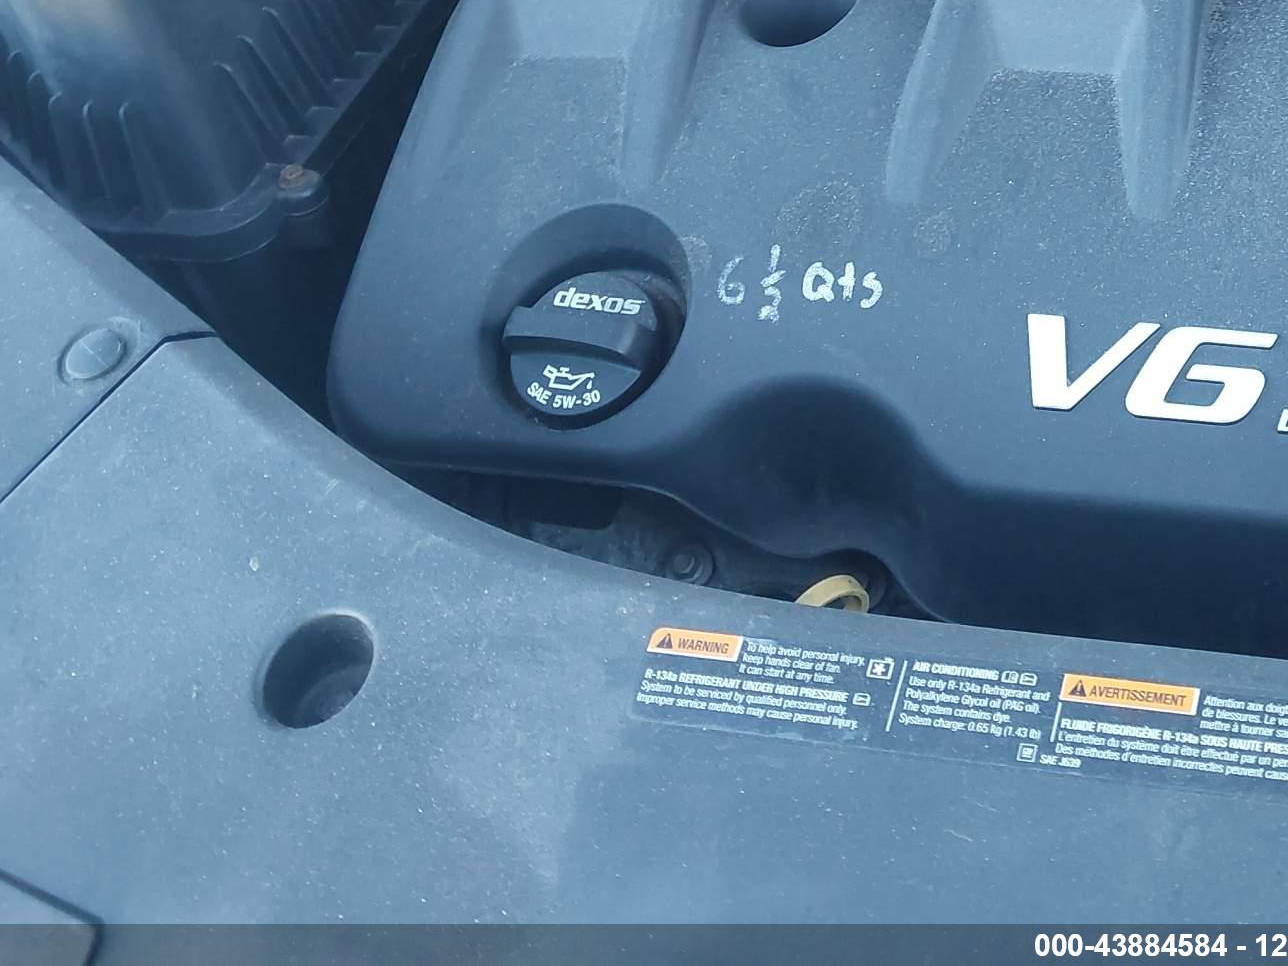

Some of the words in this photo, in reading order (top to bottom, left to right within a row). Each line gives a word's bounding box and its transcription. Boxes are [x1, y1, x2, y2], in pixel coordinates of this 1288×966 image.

[802, 260, 884, 309] Qts
[553, 287, 646, 315] dexos
[1028, 314, 1278, 425] V6
[527, 382, 552, 406] SAE
[553, 390, 601, 409] 5W-30
[677, 637, 729, 654] WARNING
[747, 641, 757, 652] To
[758, 644, 776, 656] help
[778, 646, 800, 658] avoid
[802, 647, 839, 663] personal
[739, 664, 747, 674] It
[747, 667, 763, 676] can
[764, 667, 784, 678] start
[785, 670, 795, 679] at
[796, 673, 813, 683] any
[814, 672, 834, 684] time.
[743, 653, 764, 667] keep
[765, 656, 792, 668] hands
[793, 659, 813, 672] clear
[814, 662, 824, 672] of
[825, 662, 841, 674] fan.
[912, 661, 930, 672] AIR
[931, 663, 1000, 681] CONDITIONING
[641, 680, 672, 694] System
[673, 685, 681, 695] to
[683, 686, 694, 696] be
[696, 687, 734, 701] serviced
[734, 692, 745, 704] by
[746, 693, 782, 707] qualified
[784, 698, 825, 712] personnel
[827, 701, 847, 716] only.
[645, 669, 677, 682] R-134a
[678, 672, 741, 689] REFRIGERANT
[743, 680, 774, 693] UNDER
[775, 684, 798, 696] HIGH
[799, 685, 849, 702] PRESSURE
[909, 676, 927, 686] Use
[927, 678, 946, 691] only
[948, 681, 980, 694] R-134a
[982, 684, 1031, 701] Refrigerant
[1032, 690, 1051, 701] and
[1089, 686, 1187, 707] AVERTISSEMENT
[637, 693, 674, 708] Improper
[676, 698, 707, 710] service
[708, 701, 746, 714] methods
[746, 706, 765, 718] may
[766, 709, 792, 721] cause
[793, 710, 831, 726] personal
[903, 700, 919, 712] The
[921, 704, 952, 716] system
[954, 708, 992, 720] contains
[992, 712, 1011, 724] dye.
[905, 687, 960, 705] Polyalkylene
[961, 694, 988, 708] Glycol
[989, 699, 1001, 708] oil
[1002, 699, 1024, 712] (PAG
[1204, 696, 1245, 710] Attention
[1247, 702, 1264, 711] aux
[899, 713, 932, 726] System
[933, 717, 967, 732] charge:
[968, 722, 988, 733] 0.65
[990, 723, 1003, 737] kg
[1200, 720, 1231, 732] mettre
[1240, 726, 1274, 737] tourner
[1202, 709, 1214, 718] de
[1216, 710, 1262, 724] blessures.
[1264, 715, 1276, 725] Le
[1061, 718, 1096, 731] FLUIDE
[1163, 730, 1199, 744] R-134a
[1200, 735, 1227, 747] SOUS
[1229, 739, 1262, 753] HAUTE
[1055, 743, 1074, 755] Des
[1172, 758, 1224, 773] incorrectes
[1225, 766, 1264, 779] peuvent
[1107, 737, 1120, 748] du
[1161, 743, 1179, 755] doit
[1241, 755, 1257, 766] par
[1258, 757, 1271, 766] un
